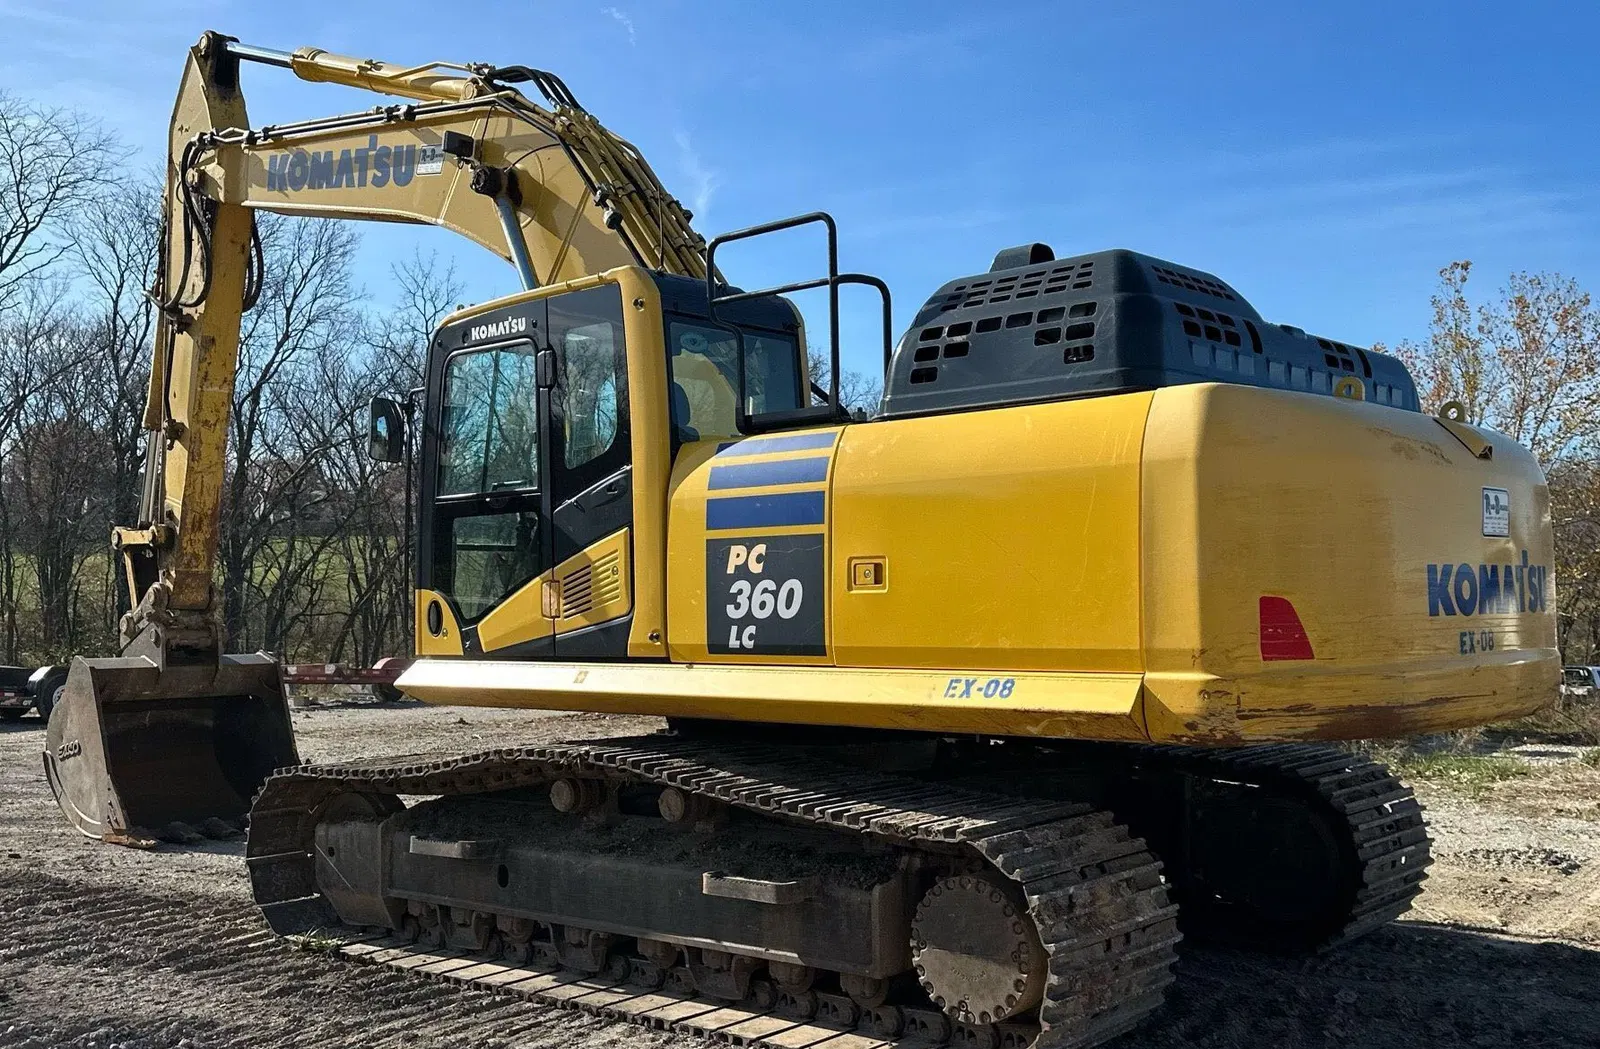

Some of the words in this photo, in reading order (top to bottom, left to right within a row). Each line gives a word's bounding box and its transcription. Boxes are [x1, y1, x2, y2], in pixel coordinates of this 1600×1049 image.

[267, 134, 416, 192] KOMATSU
[471, 316, 526, 340] KOMATSU
[726, 544, 767, 574] PC
[1427, 550, 1546, 617] KOMATSU
[726, 578, 803, 619] 360
[728, 625, 756, 649] LC
[1460, 631, 1494, 655] EX-08
[944, 678, 1016, 698] EX-08
